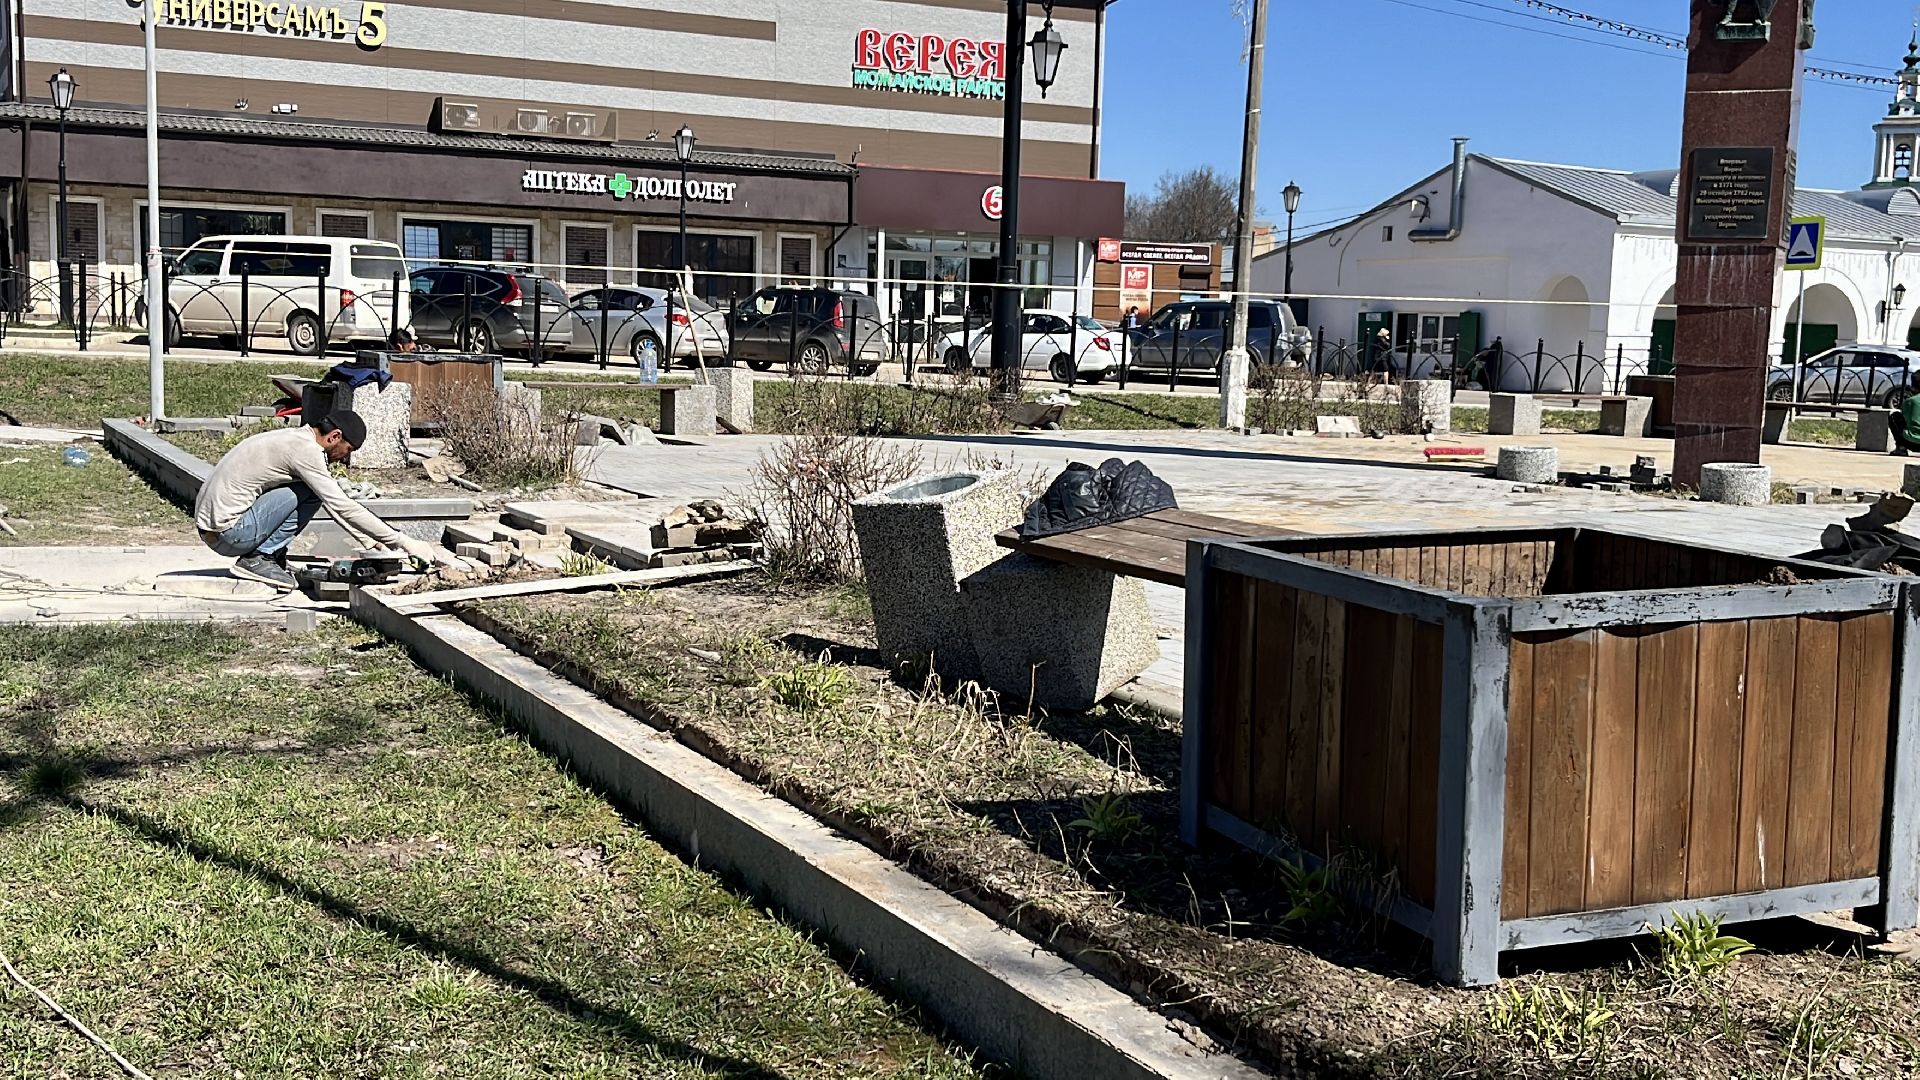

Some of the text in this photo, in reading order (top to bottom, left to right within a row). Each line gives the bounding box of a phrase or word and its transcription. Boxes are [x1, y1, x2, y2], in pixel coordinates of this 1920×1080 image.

[356, 2, 387, 46] 5
[854, 28, 1005, 80] ВЕРЕЯ
[854, 69, 952, 92] МОЖАЙСКОЕ
[522, 169, 737, 201] АПТЕКА ДОЛГОЛЕТ
